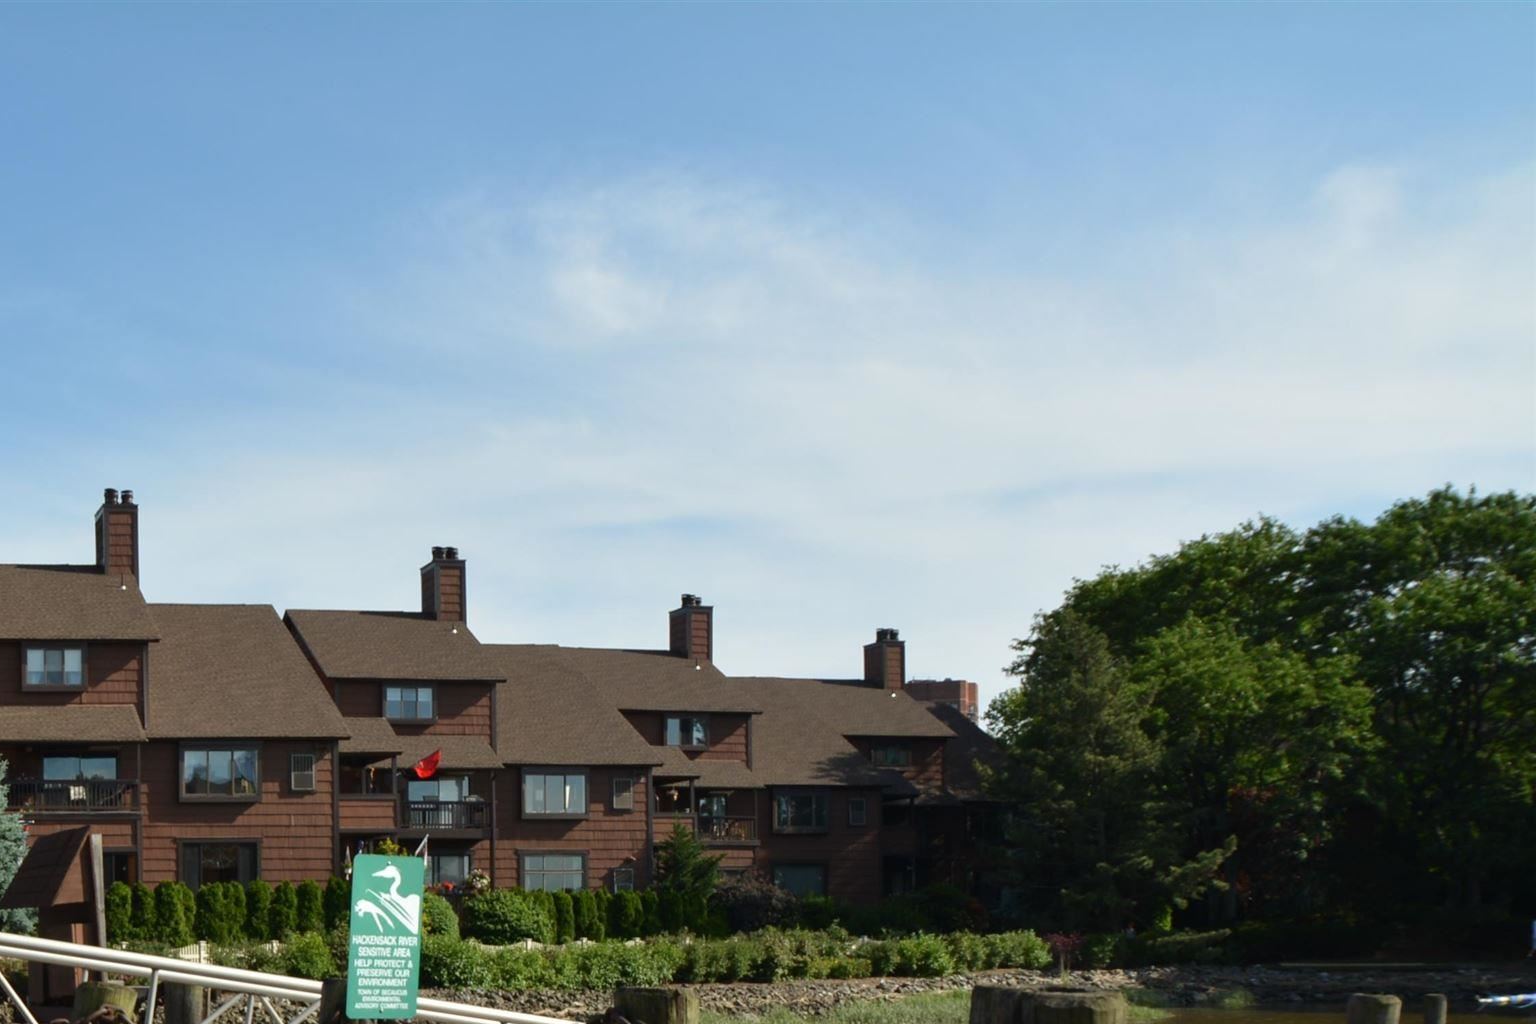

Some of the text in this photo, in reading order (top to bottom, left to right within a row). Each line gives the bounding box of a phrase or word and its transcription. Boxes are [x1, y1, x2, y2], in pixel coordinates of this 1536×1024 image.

[352, 934, 418, 946] HACKENSACK RIVER
[358, 946, 411, 957] SENSITIVE AREA
[354, 958, 372, 967] HELP
[374, 959, 405, 967] PROTECT
[357, 968, 410, 977] PRESERVE OUR
[358, 978, 408, 986] ENVIRONMENT
